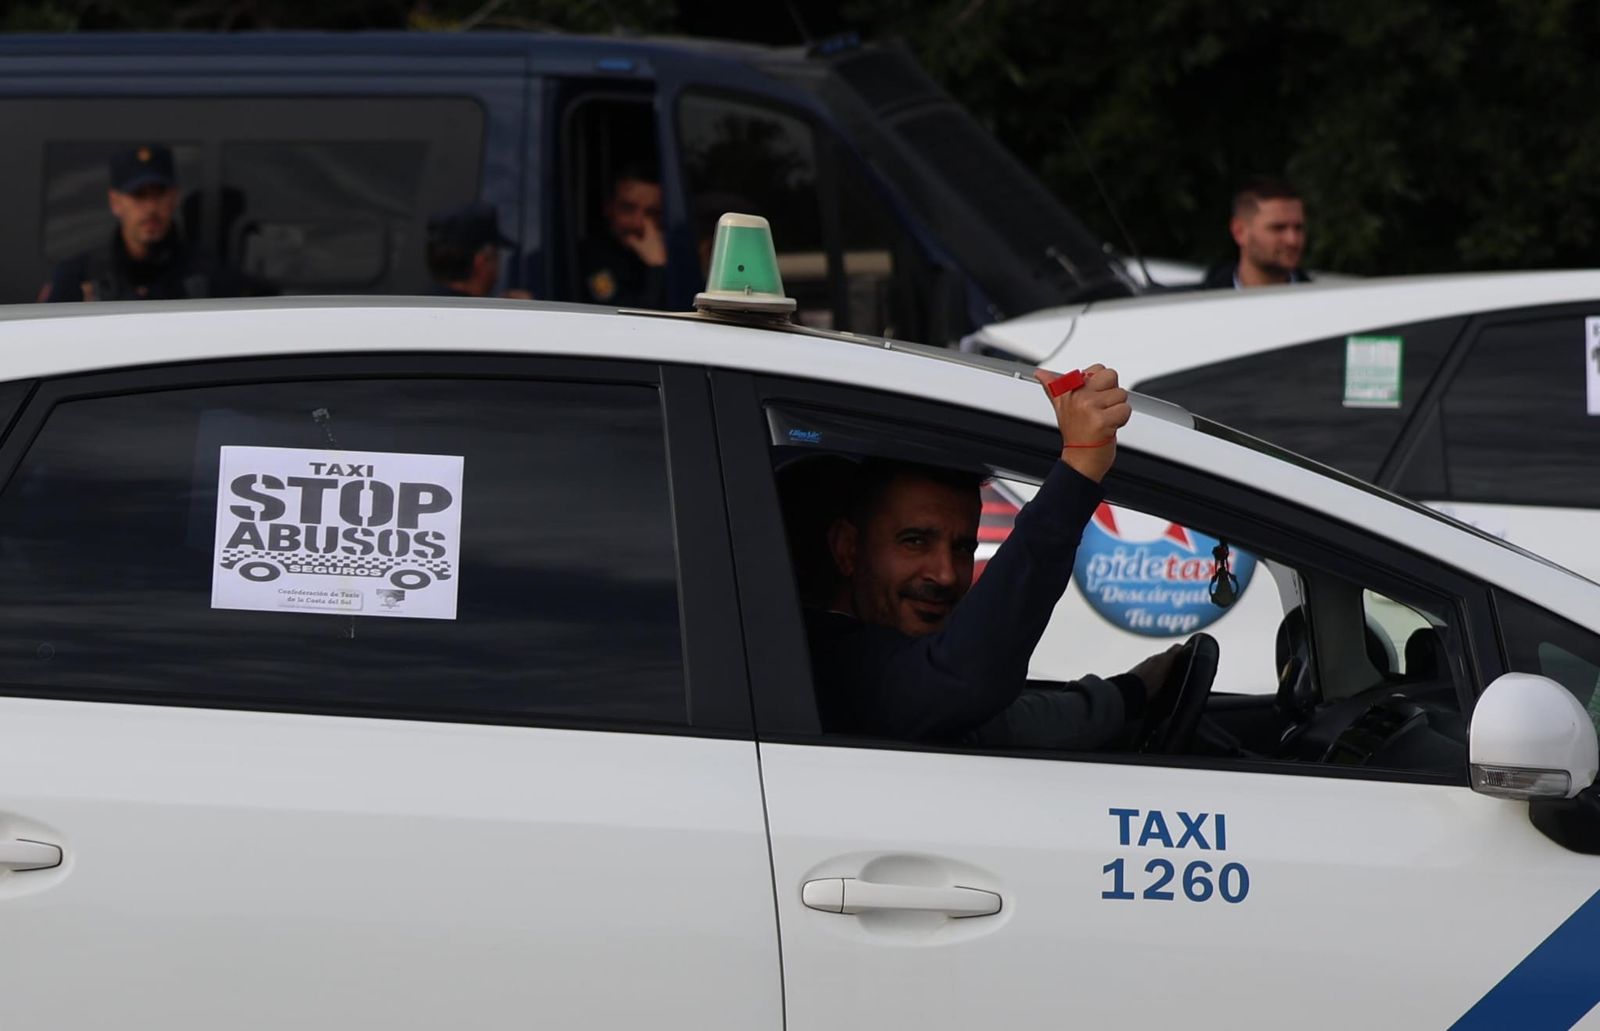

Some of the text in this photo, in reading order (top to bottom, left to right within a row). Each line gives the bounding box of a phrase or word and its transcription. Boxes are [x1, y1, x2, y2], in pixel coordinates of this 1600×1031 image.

[309, 462, 374, 477] TAXI
[229, 473, 453, 529] STOP
[225, 521, 447, 559] ABUSOS
[289, 563, 383, 577] SEGUROS
[278, 588, 328, 597] Confederación
[1100, 584, 1213, 607] Descárgat
[1125, 607, 1200, 632] Tu app
[1109, 808, 1227, 851] TAXI
[1101, 858, 1250, 903] 1260
